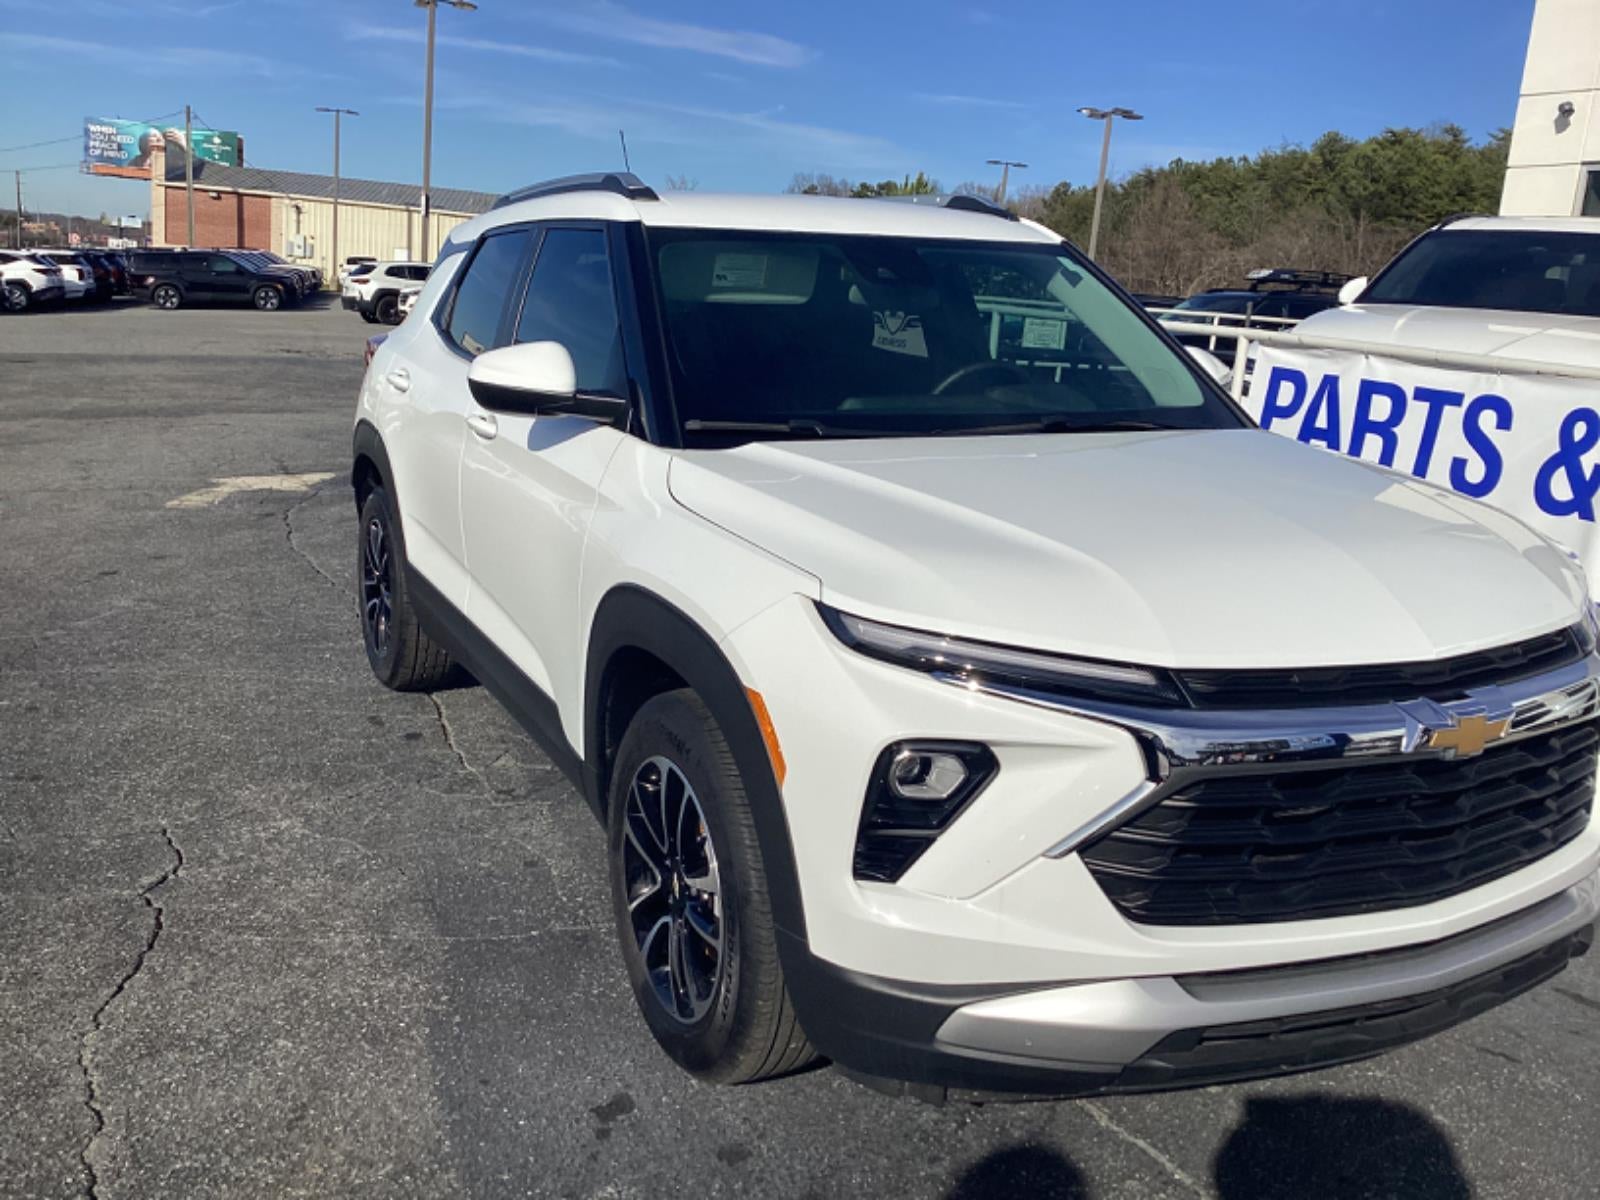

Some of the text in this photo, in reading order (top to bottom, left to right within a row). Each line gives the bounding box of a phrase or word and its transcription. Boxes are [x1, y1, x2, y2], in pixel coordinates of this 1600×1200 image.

[89, 124, 116, 134] WHEN
[90, 132, 134, 144] YOU NEED
[103, 150, 128, 159] MIND
[1260, 366, 1600, 522] PARTS &
